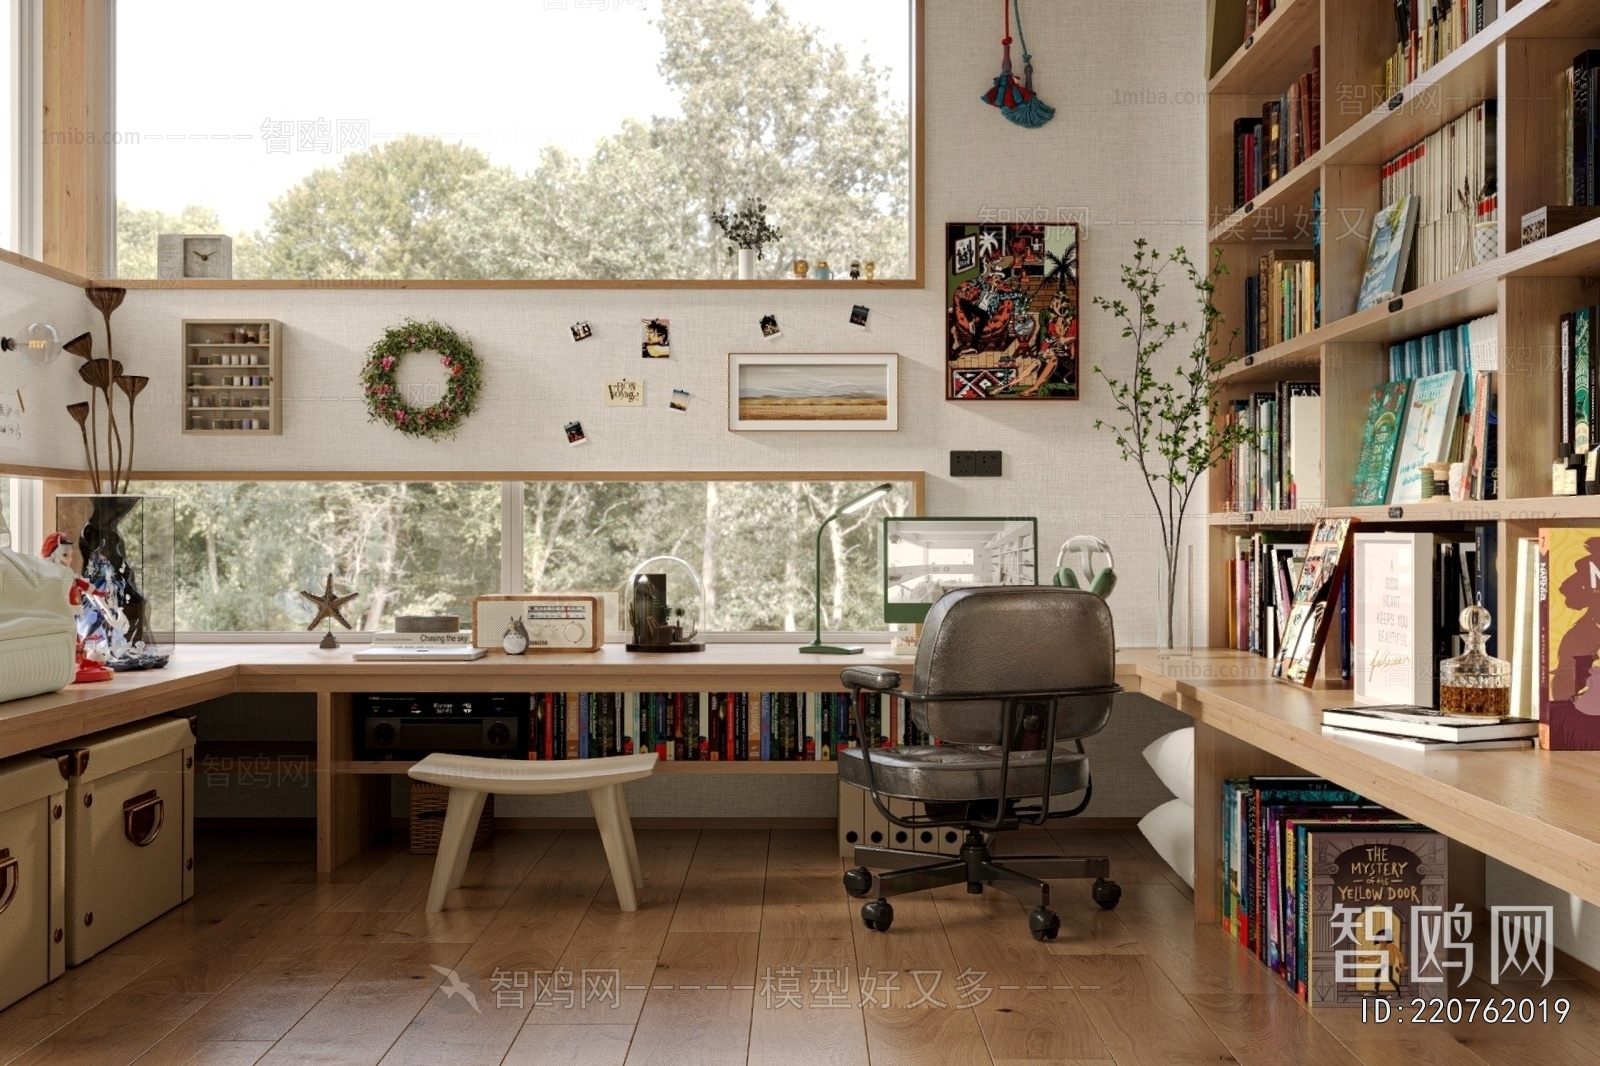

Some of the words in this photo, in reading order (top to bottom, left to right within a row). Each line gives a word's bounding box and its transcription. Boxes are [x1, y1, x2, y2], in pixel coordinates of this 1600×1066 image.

[1389, 560, 1395, 572] A
[1384, 577, 1400, 590] GOOD
[1383, 595, 1401, 609] HEART
[1376, 612, 1395, 627] KEEPS
[1397, 614, 1409, 629] YOU
[420, 634, 445, 644] Chasing
[446, 634, 456, 642] the
[457, 634, 469, 644] sky
[1378, 629, 1408, 647] BEAUTIFUL
[1366, 845, 1388, 862] THE
[1351, 862, 1408, 878] MYSTERY
[1338, 886, 1383, 902] YELLOW
[1388, 885, 1420, 904] DOOR
